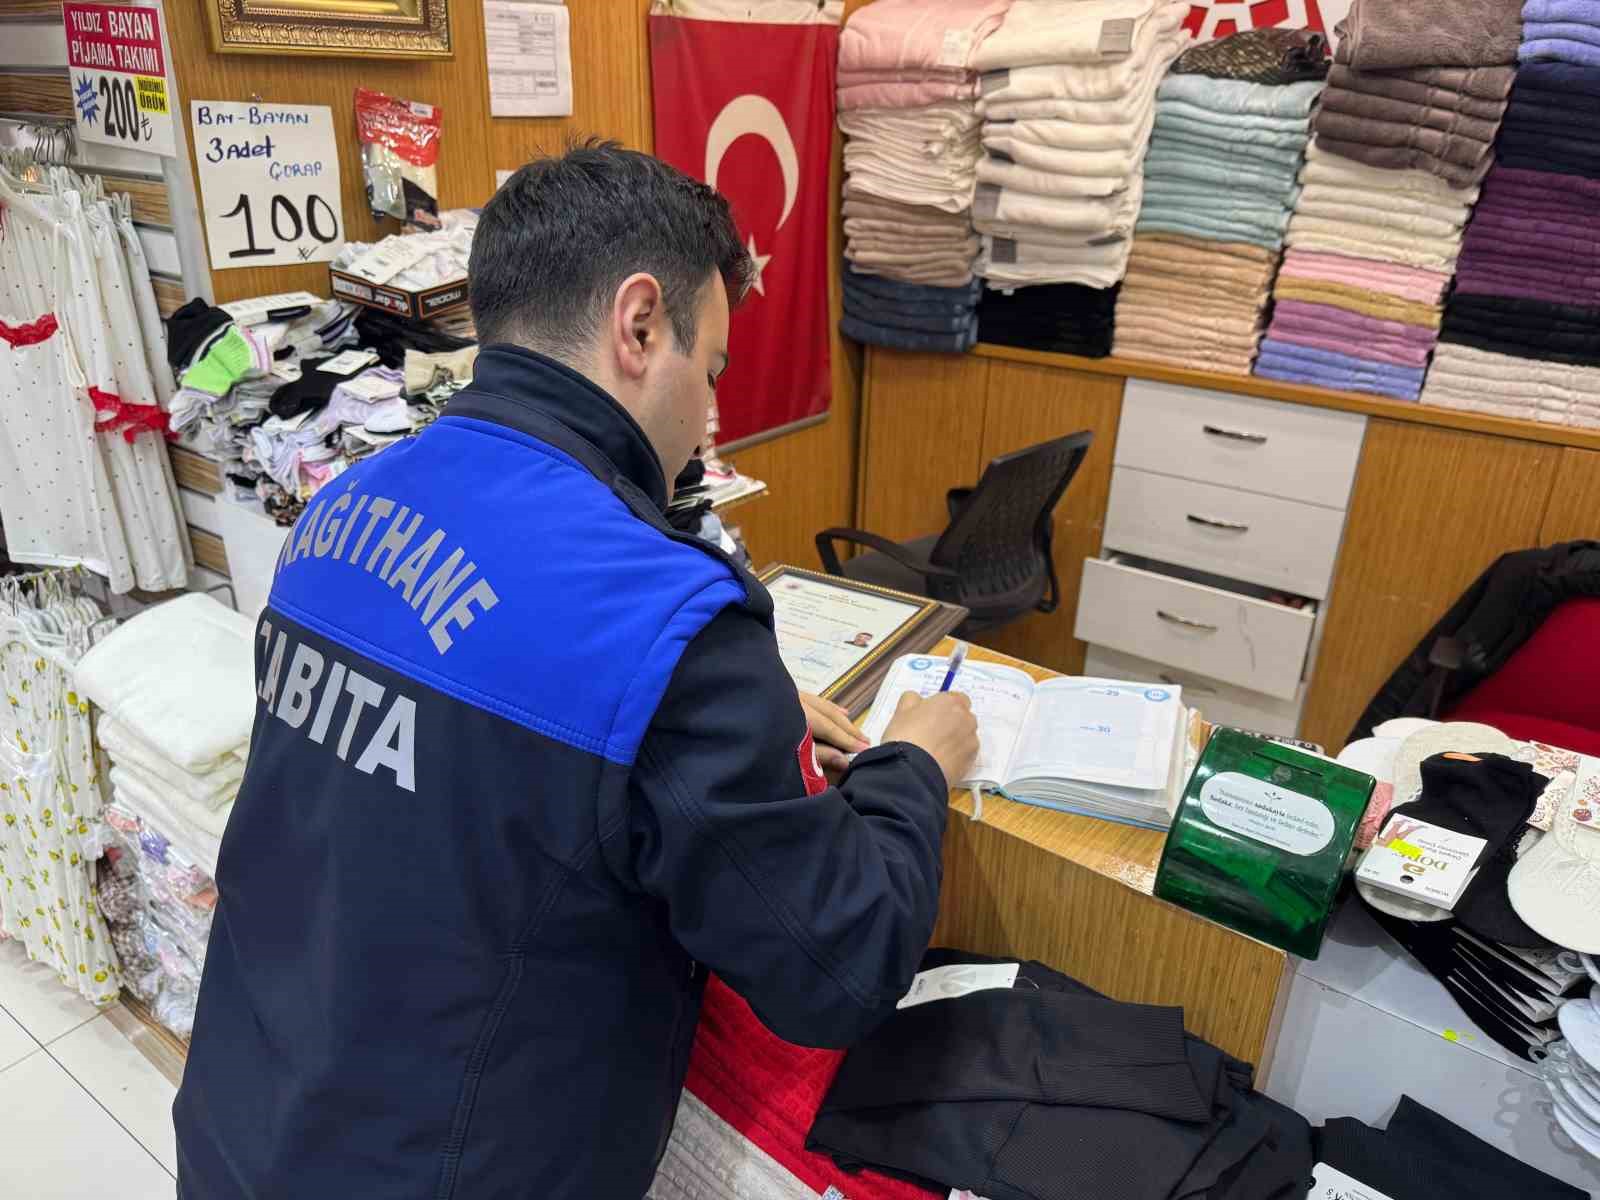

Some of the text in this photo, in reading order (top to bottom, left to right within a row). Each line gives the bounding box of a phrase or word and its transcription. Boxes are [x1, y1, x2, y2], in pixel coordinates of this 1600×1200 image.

[71, 10, 155, 41] YILDIZ BAYAN
[71, 35, 160, 73] PİJAMA TAKIMI
[99, 75, 140, 142] 200
[139, 92, 166, 111] ÜRÜN
[219, 193, 338, 259] 100
